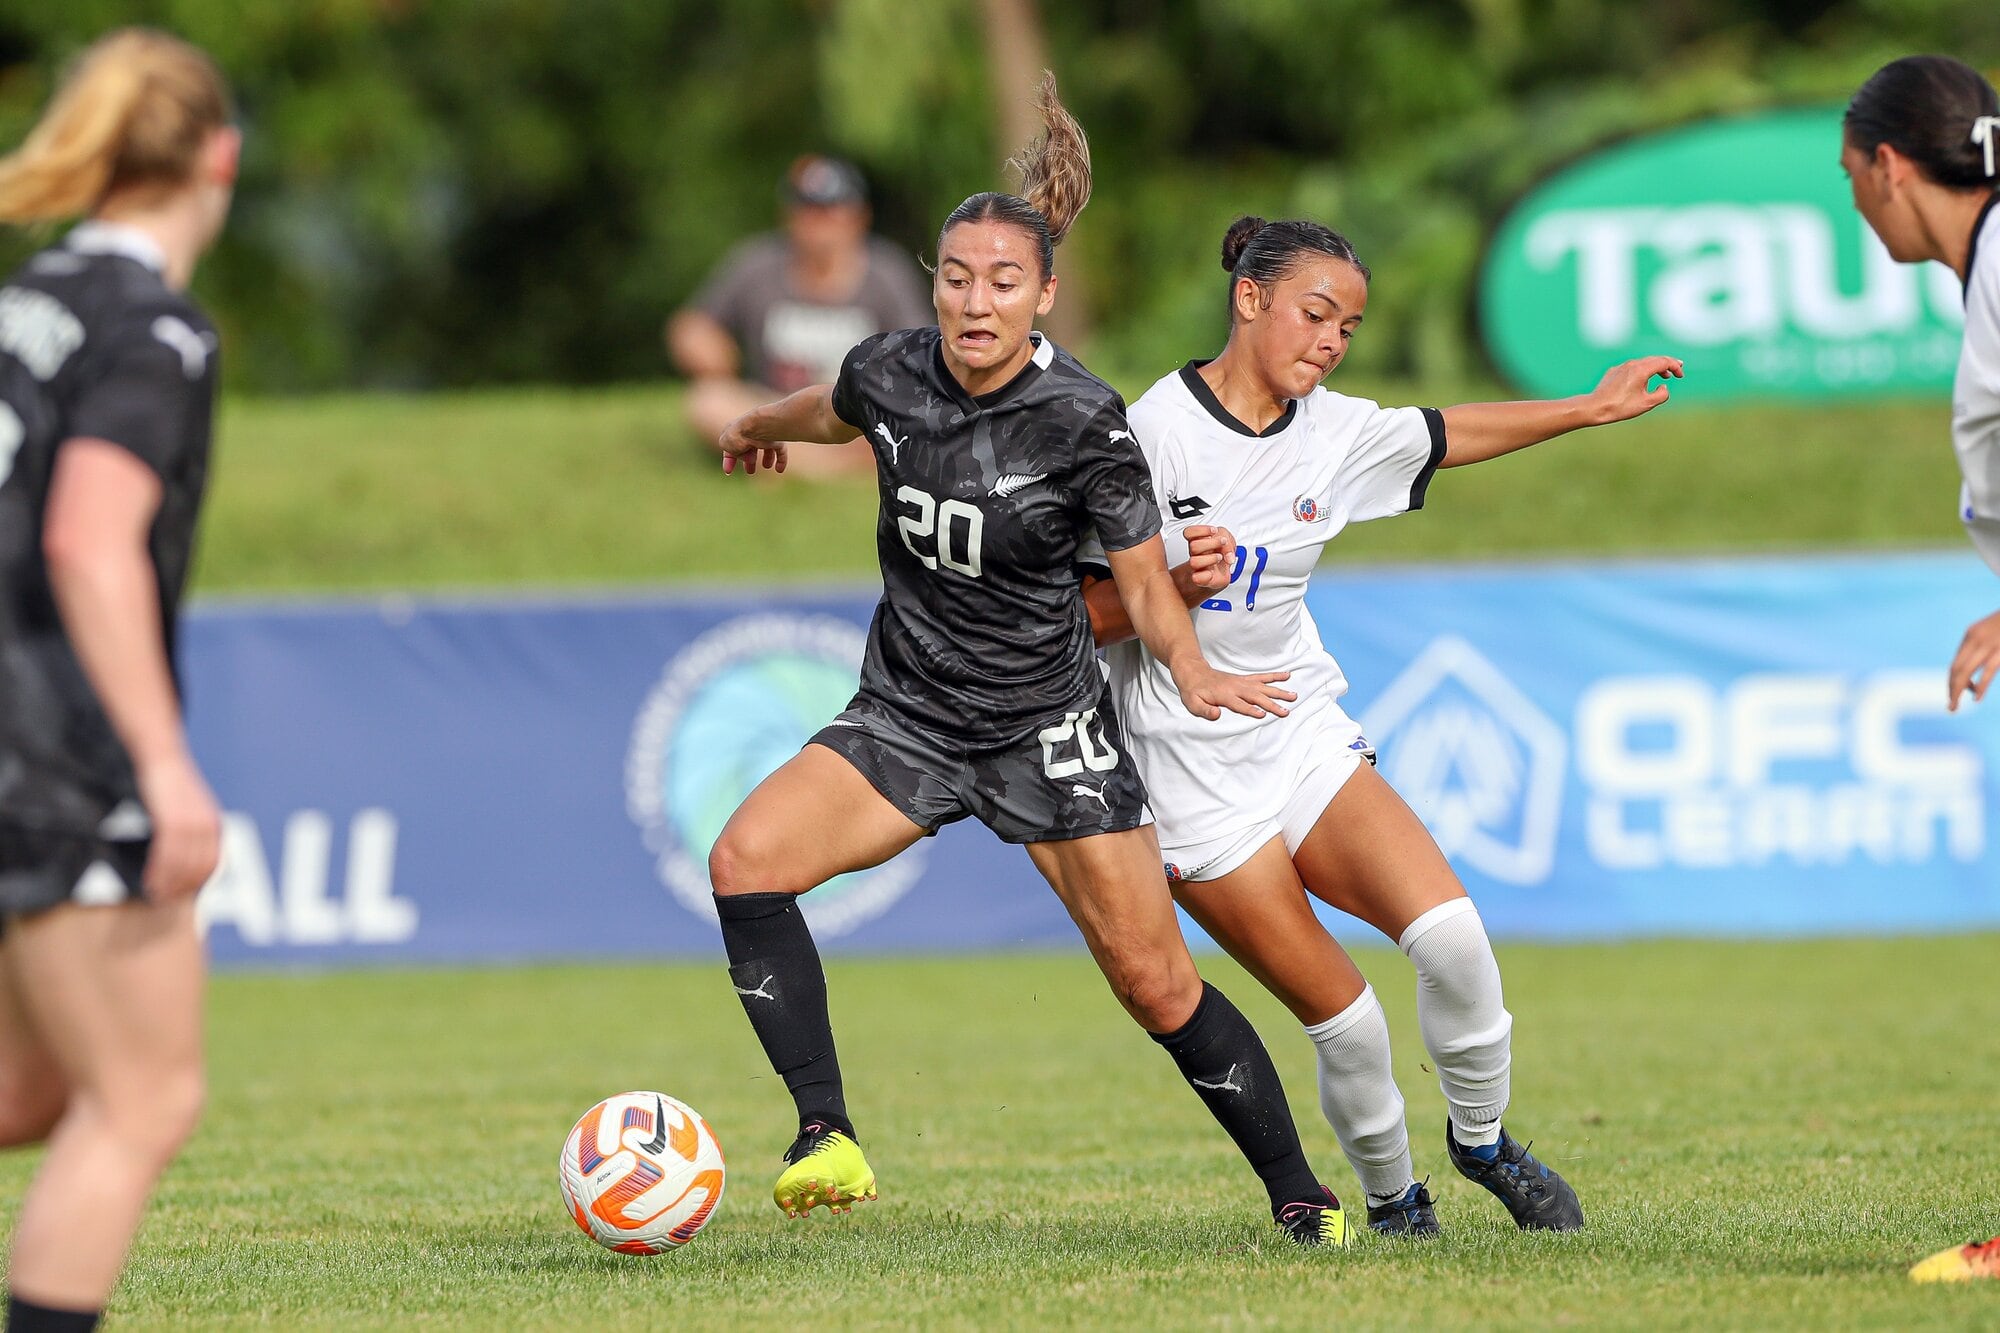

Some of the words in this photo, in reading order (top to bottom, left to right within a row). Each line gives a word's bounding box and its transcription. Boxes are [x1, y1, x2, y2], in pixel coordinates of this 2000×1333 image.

[1525, 203, 1965, 346] Tau
[897, 485, 984, 577] 20
[1038, 707, 1119, 779] 20
[1578, 676, 1984, 796] OFC
